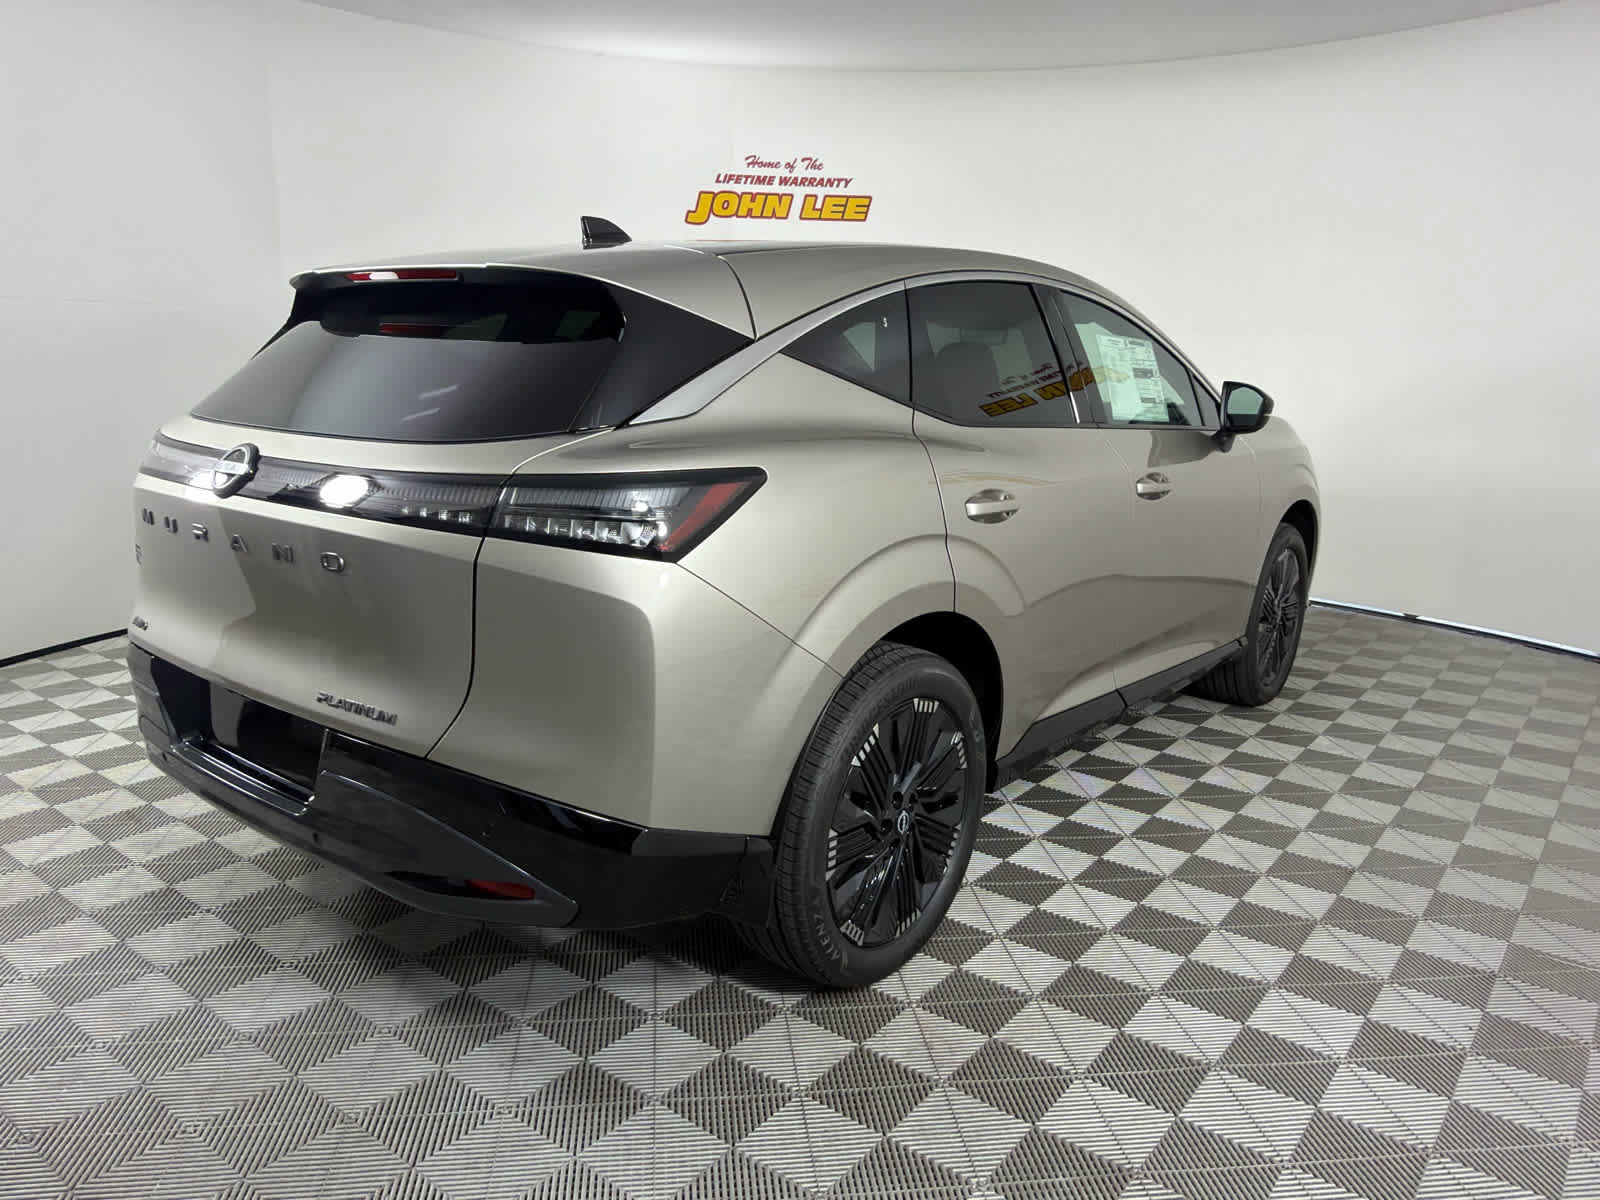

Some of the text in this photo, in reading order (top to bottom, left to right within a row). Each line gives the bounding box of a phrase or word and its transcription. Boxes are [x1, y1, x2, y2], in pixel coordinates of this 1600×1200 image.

[745, 155, 824, 173] Home of The
[715, 173, 853, 189] LIFETIME WARRANTY
[685, 190, 872, 226] JOHN LEE
[317, 691, 398, 727] PLATINUM
